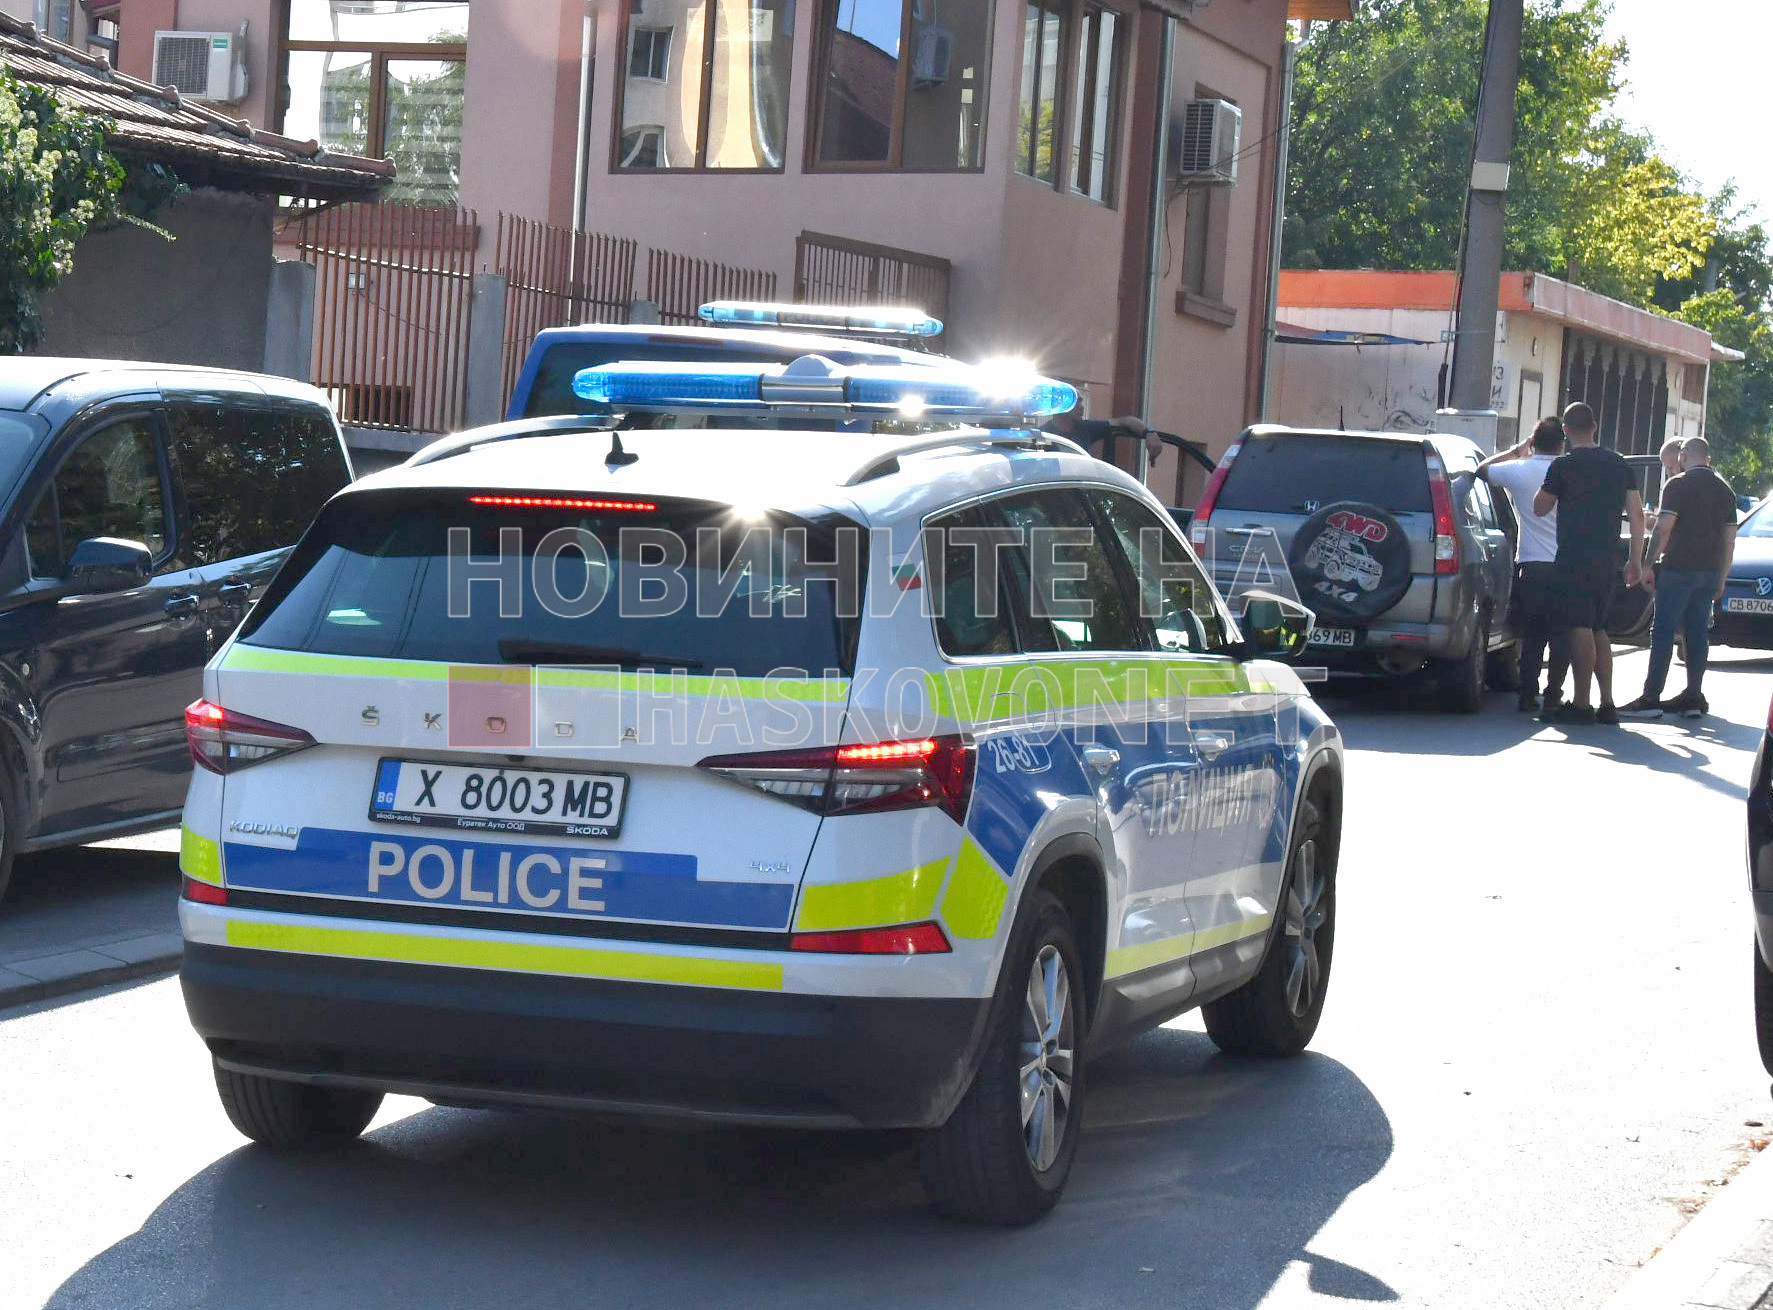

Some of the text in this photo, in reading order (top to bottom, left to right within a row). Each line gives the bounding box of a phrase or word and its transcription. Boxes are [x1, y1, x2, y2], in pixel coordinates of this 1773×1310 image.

[1325, 511, 1387, 542] 4WD
[1332, 630, 1352, 644] MB
[360, 705, 639, 743] ŠKODA
[377, 791, 394, 804] BG
[415, 769, 614, 819] X 8003 MB
[229, 820, 299, 839] KODIAQ
[506, 822, 525, 831] ООД
[566, 825, 609, 836] ŠKODA
[750, 860, 790, 873] 4x4
[368, 841, 606, 912] POLICE
